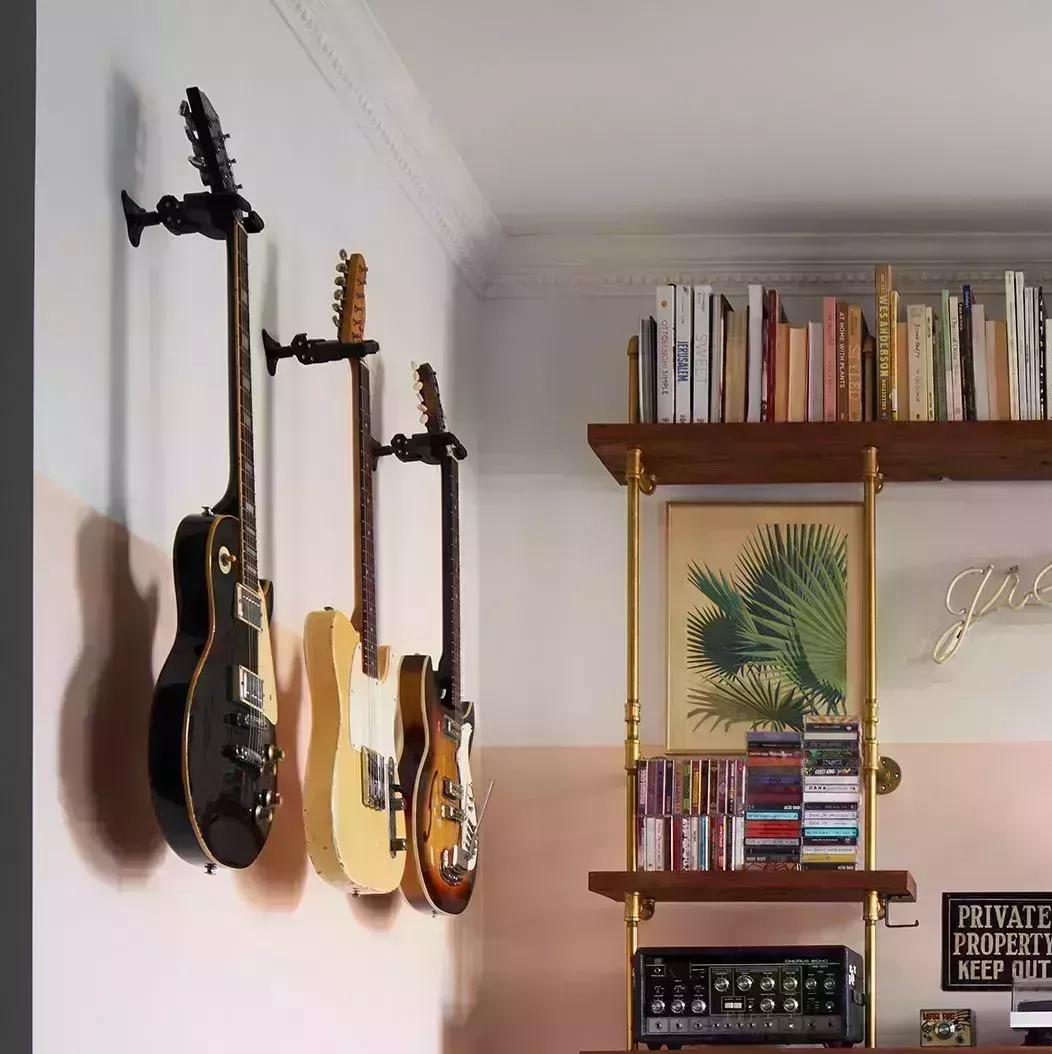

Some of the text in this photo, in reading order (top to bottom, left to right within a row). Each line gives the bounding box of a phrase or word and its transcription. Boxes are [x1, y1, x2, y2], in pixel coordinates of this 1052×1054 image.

[839, 312, 845, 320] AT
[878, 294, 889, 377] WES ANDERSON
[661, 320, 669, 396] OTTOLENGHI SIMPLE
[677, 341, 689, 382] JERUSALEM
[695, 334, 707, 385] SWEET
[849, 344, 861, 400] STYLED
[958, 905, 1052, 929] PRIVATE
[959, 960, 1051, 980] KEEP OUT
